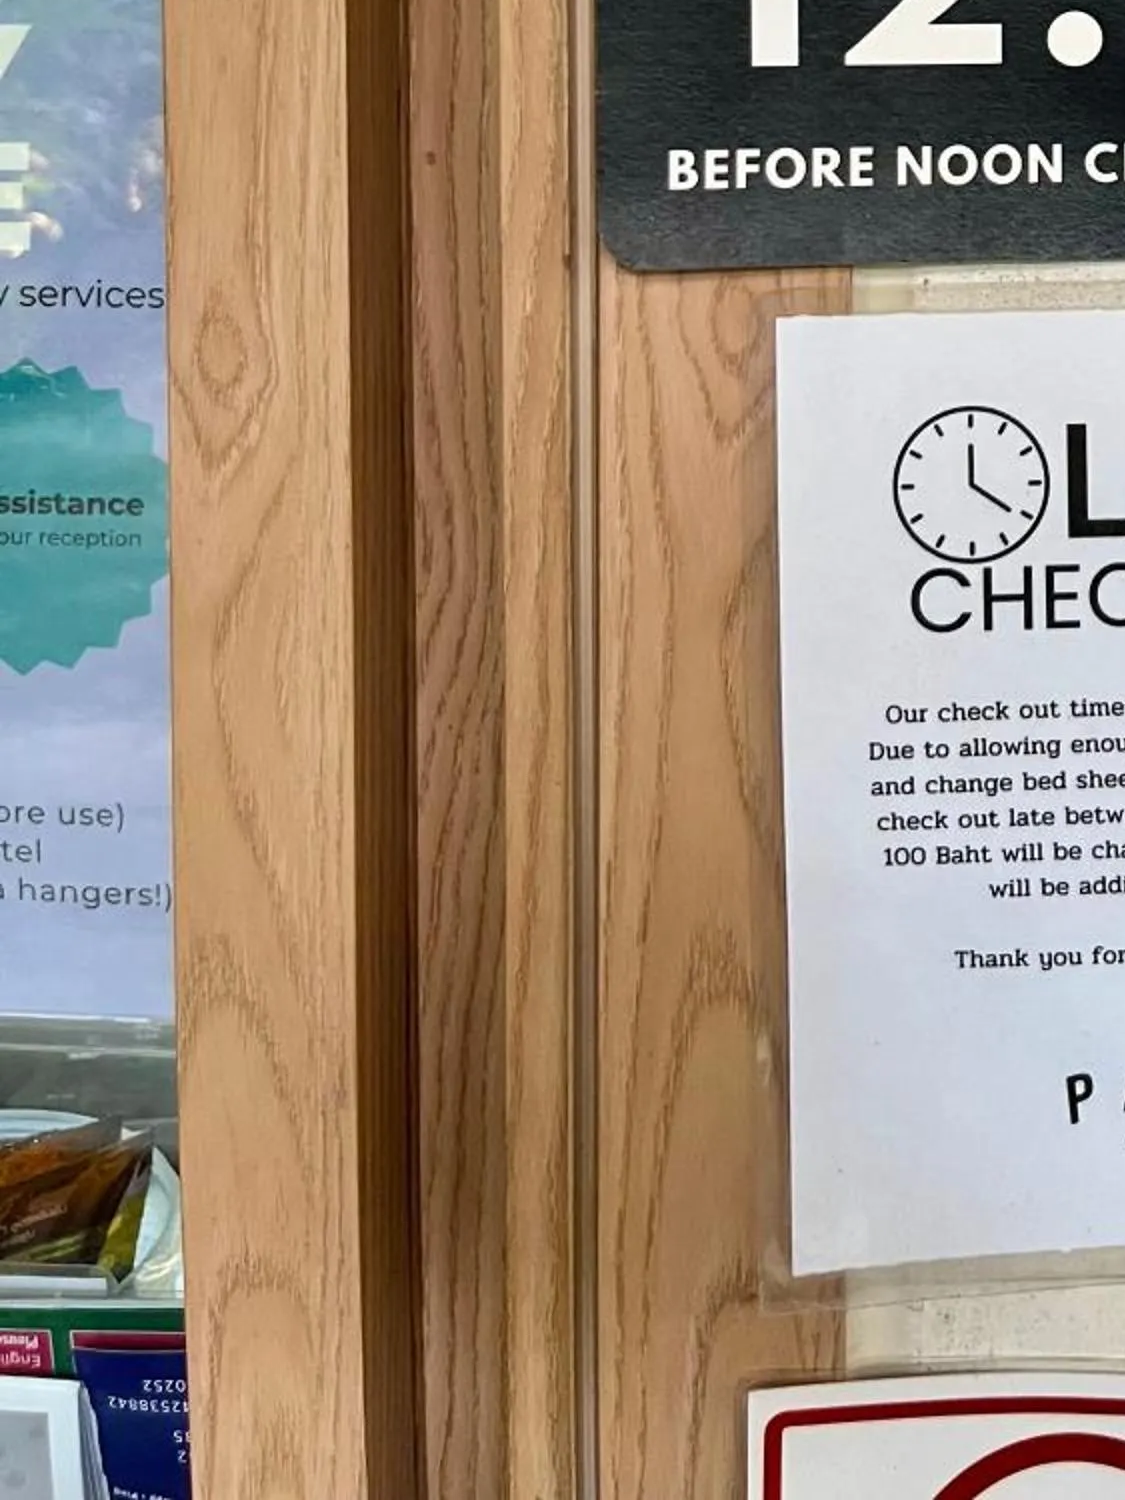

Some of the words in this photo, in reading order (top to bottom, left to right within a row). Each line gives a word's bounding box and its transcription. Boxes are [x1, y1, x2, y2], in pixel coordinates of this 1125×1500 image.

[667, 146, 874, 191] BEFORE
[896, 143, 1063, 187] NOON
[18, 278, 165, 309] services
[0, 488, 145, 517] ssistance
[38, 529, 142, 551] reception
[885, 704, 929, 725] Our
[937, 700, 1010, 723] check
[1019, 700, 1061, 720] out
[1069, 697, 1125, 718] time
[869, 741, 915, 761] Due
[923, 741, 950, 759] to
[959, 735, 1061, 760] allowing
[870, 775, 916, 797] and
[925, 774, 1013, 798] change
[1022, 770, 1067, 791] bed
[58, 802, 125, 834] use)
[876, 809, 949, 832] check
[957, 810, 1001, 829] out
[1008, 807, 1056, 828] late
[883, 846, 927, 867] 100
[935, 844, 993, 865] Baht
[1001, 841, 1044, 863] will
[1052, 841, 1083, 861] be
[18, 876, 172, 913] hangers!)
[988, 877, 1032, 899] will
[1039, 877, 1070, 897] be
[953, 948, 1030, 969] Thank
[1038, 951, 1083, 972] you
